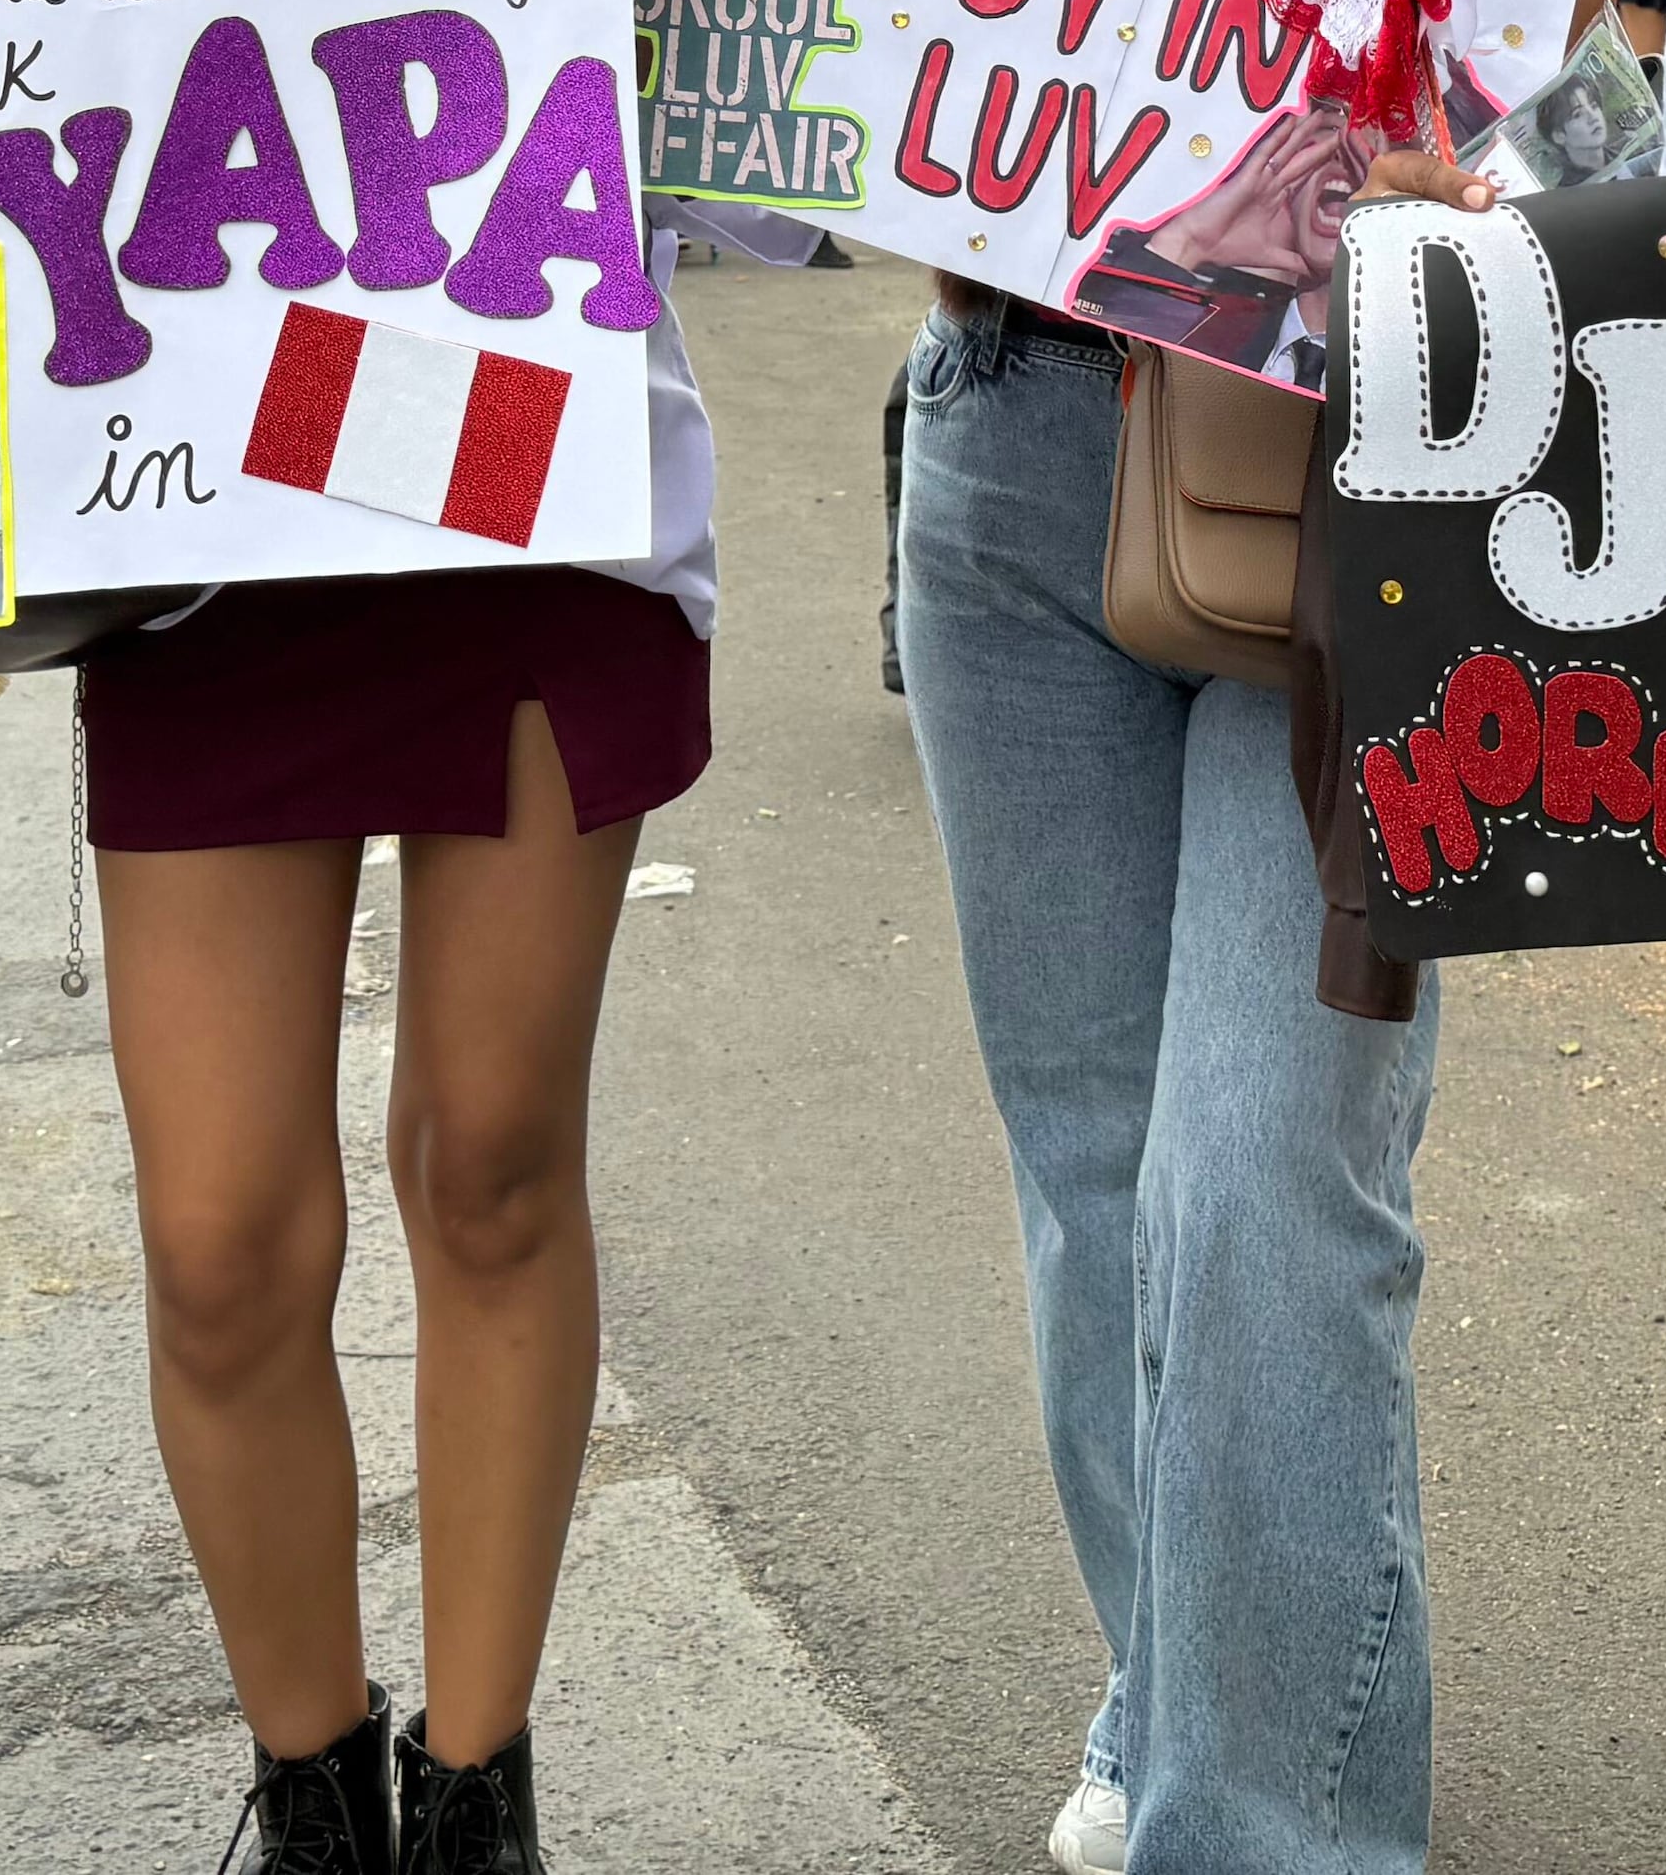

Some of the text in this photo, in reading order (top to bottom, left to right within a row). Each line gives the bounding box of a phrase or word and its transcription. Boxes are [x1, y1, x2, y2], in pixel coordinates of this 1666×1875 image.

[662, 28, 804, 111] LUV
[895, 38, 1173, 242] LUV
[76, 413, 217, 515] in
